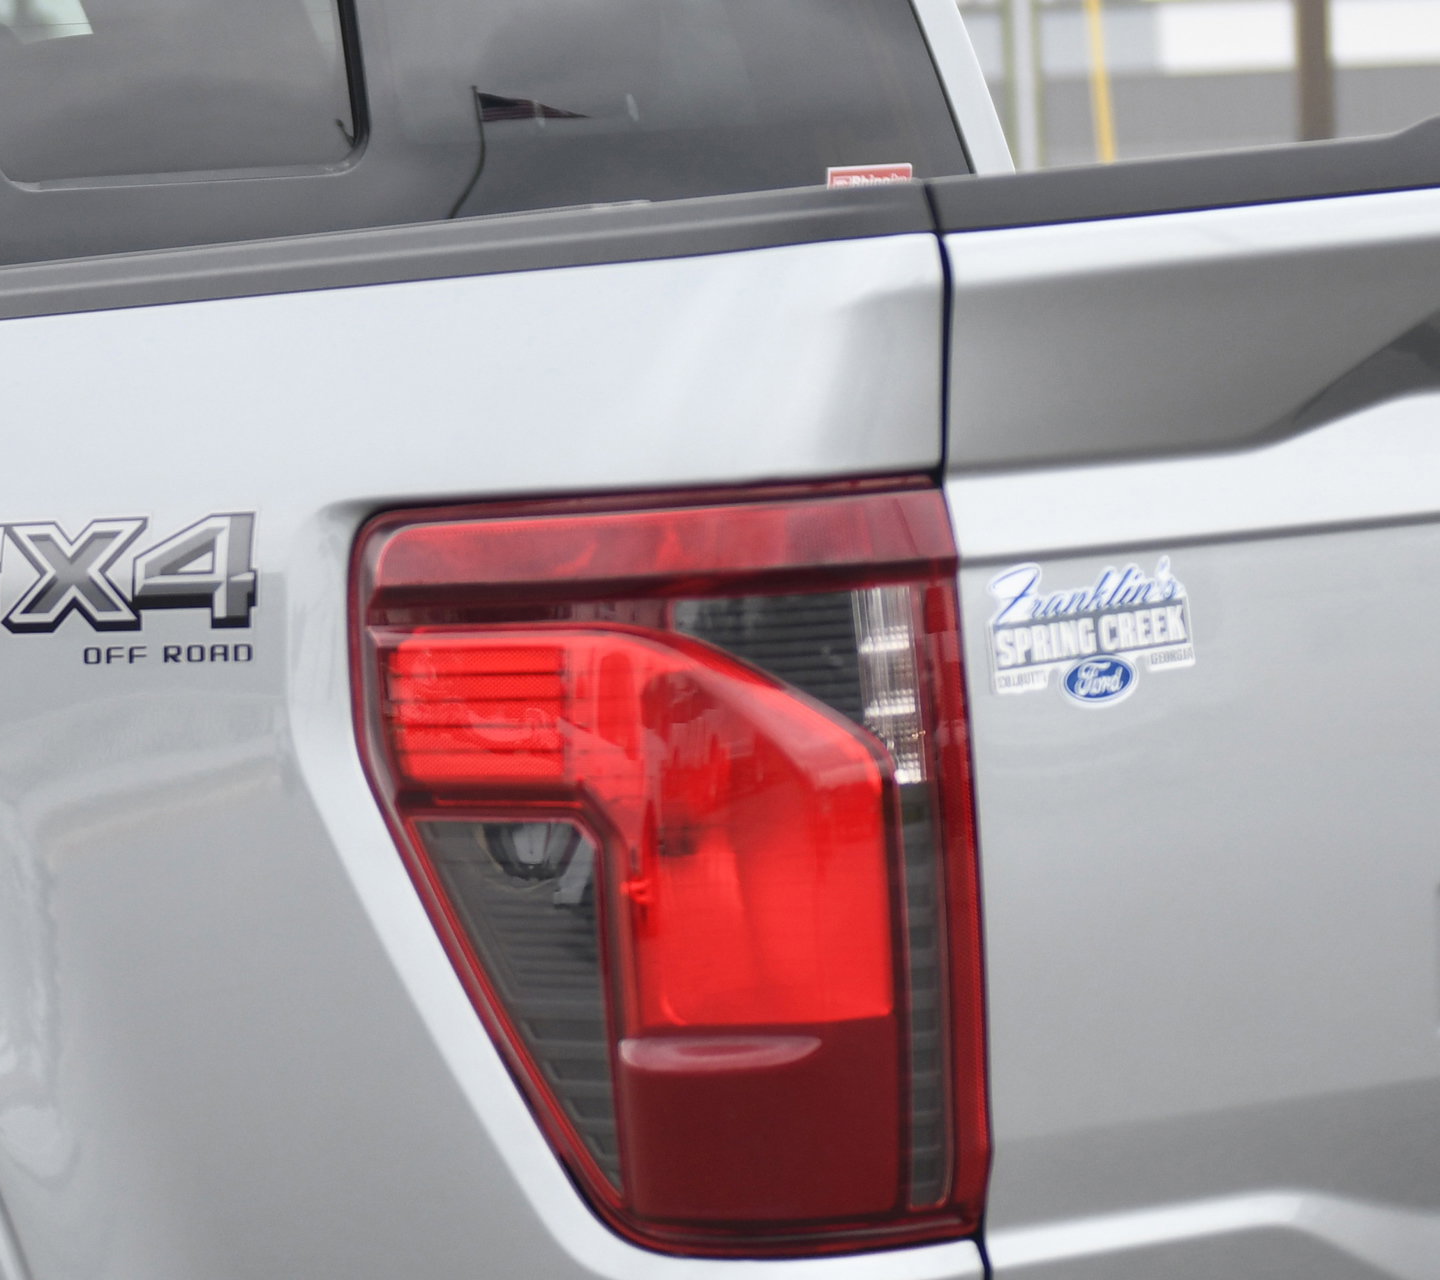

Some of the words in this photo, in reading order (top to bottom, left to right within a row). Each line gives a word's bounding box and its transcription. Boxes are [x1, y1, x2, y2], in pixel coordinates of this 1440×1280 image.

[990, 559, 1178, 625] Franklin's
[83, 645, 148, 665] OFF
[162, 643, 254, 664] ROAD
[994, 617, 1098, 668] SPRING
[1097, 604, 1189, 651] CREEK
[1074, 661, 1125, 697] Ford
